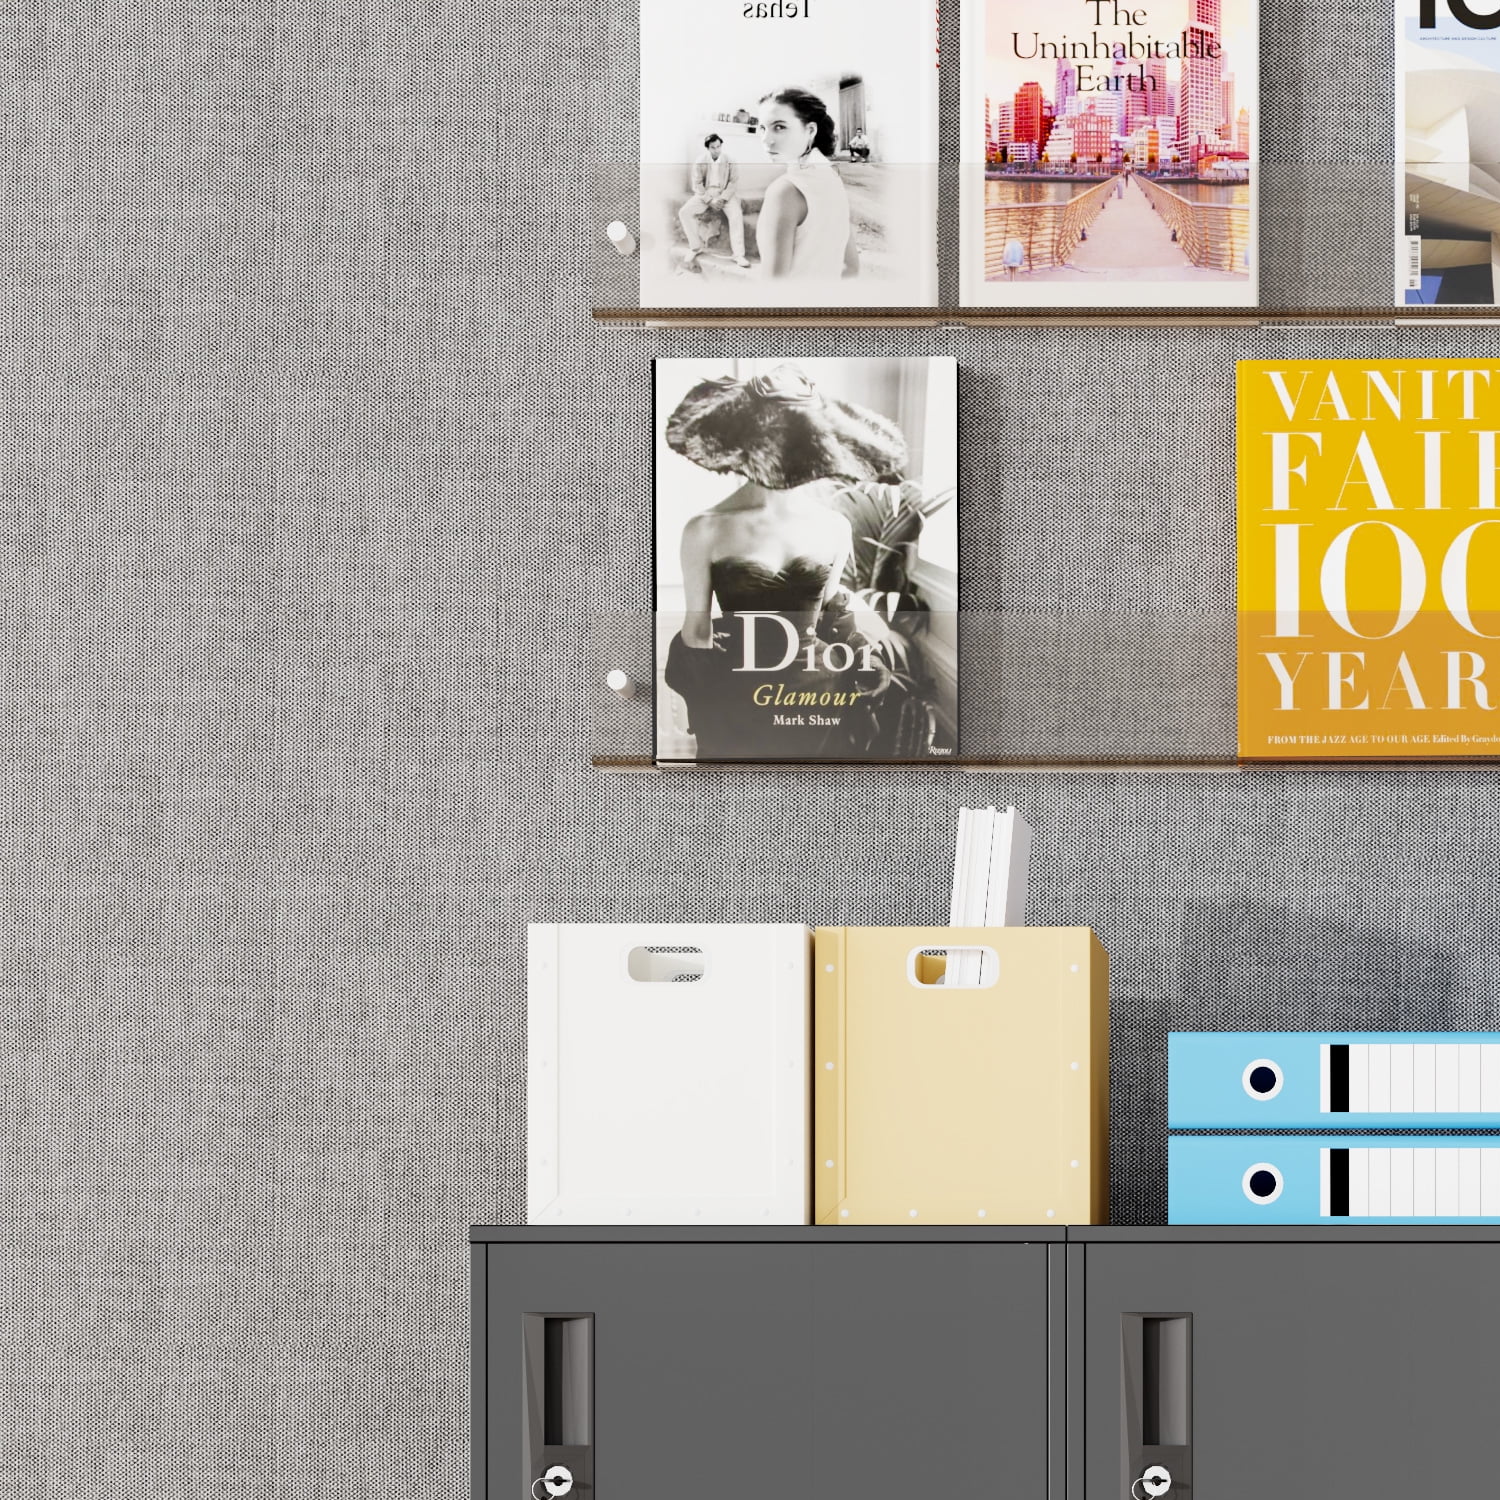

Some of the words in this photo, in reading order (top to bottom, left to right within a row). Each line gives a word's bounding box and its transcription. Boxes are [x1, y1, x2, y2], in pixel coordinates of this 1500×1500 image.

[1086, 0, 1147, 26] The
[1011, 31, 1222, 59] Uninhabitable
[1076, 64, 1157, 92] Earth
[731, 610, 884, 673] Dior
[753, 683, 861, 706] Glamour
[773, 714, 805, 726] Mark
[809, 714, 841, 726] Shaw
[1267, 735, 1297, 744] FROM
[1299, 735, 1321, 744] THE
[1321, 735, 1346, 744] JAZZ
[1350, 735, 1369, 744] AGE
[1370, 735, 1385, 744] TO
[1386, 735, 1408, 744] OUR
[1411, 735, 1431, 744] AGE
[1432, 734, 1459, 743] Edited
[1460, 734, 1471, 745] By
